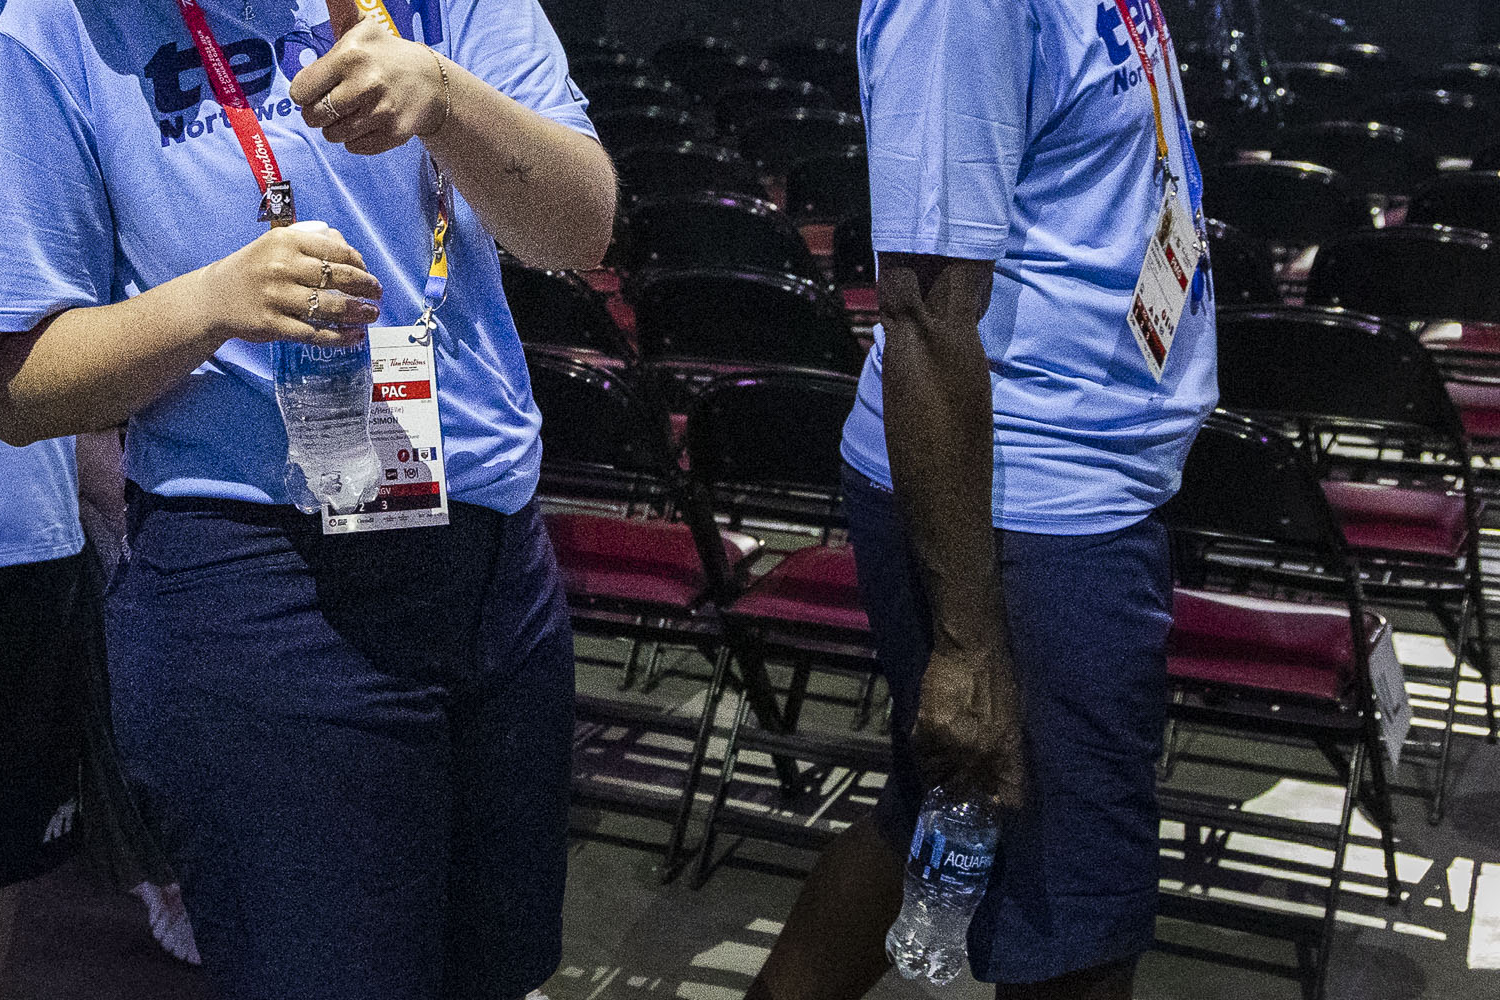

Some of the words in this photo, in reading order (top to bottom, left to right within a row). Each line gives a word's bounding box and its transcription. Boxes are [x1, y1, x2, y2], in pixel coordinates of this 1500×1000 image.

[381, 385, 407, 398] PAC
[359, 503, 366, 512] 2
[381, 500, 388, 510] 3
